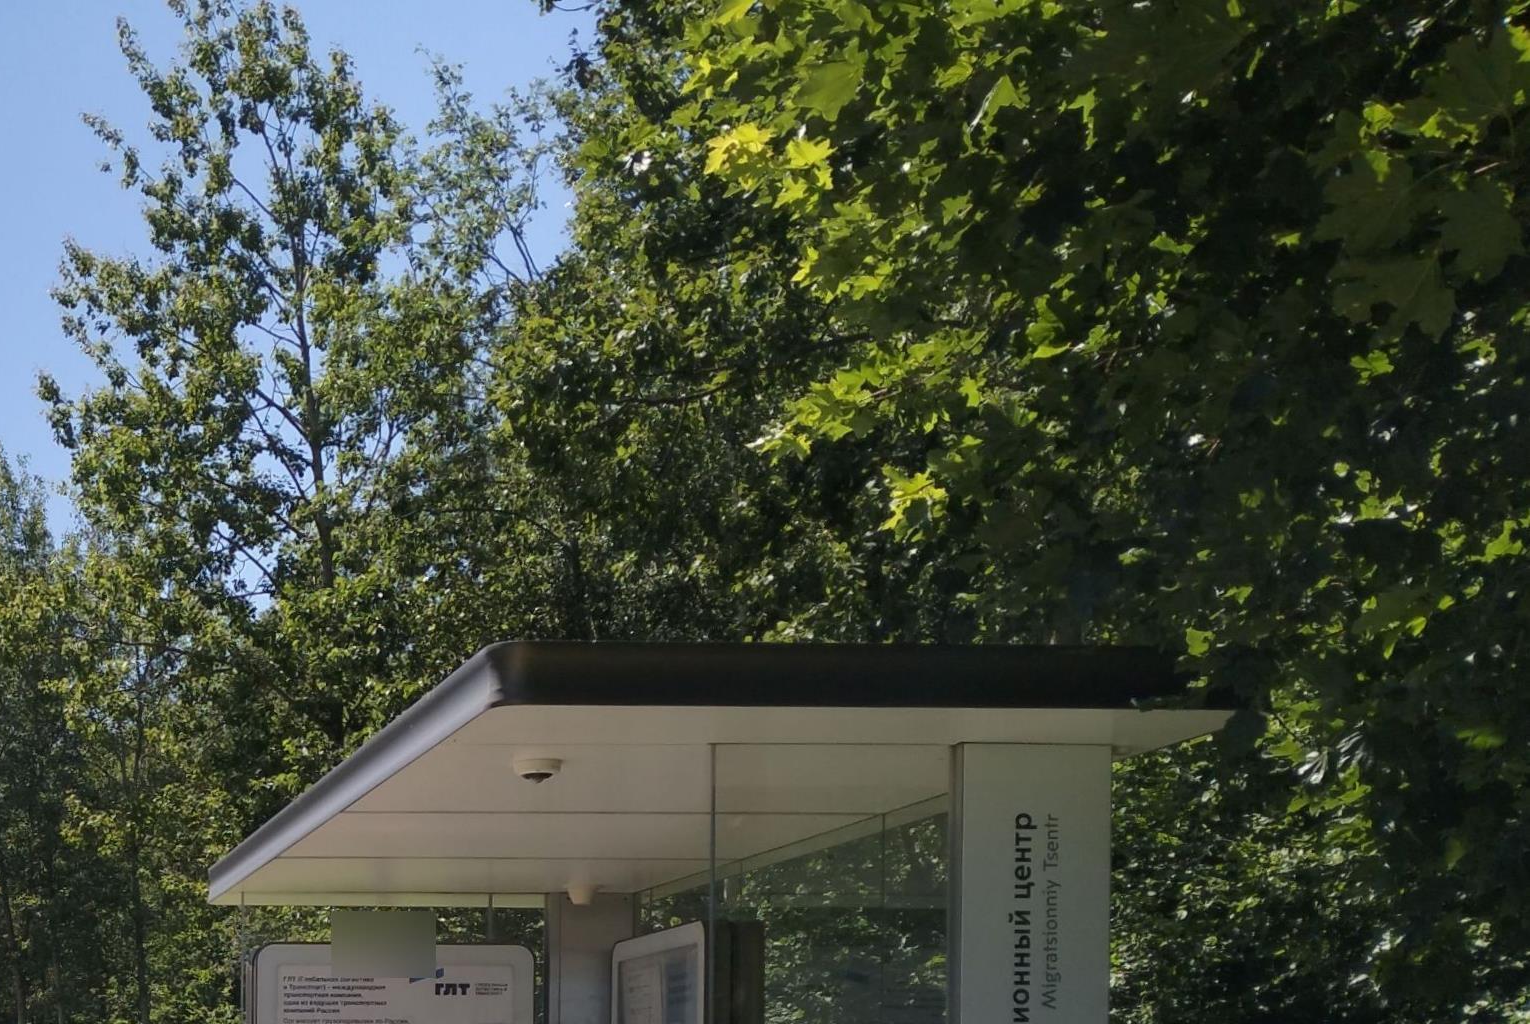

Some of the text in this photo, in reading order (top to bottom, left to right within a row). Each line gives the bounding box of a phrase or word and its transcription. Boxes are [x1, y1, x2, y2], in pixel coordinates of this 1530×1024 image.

[1014, 811, 1038, 899] центр
[1042, 813, 1062, 1010] Migratsionniy Tsentr
[435, 983, 470, 995] ГЛТ
